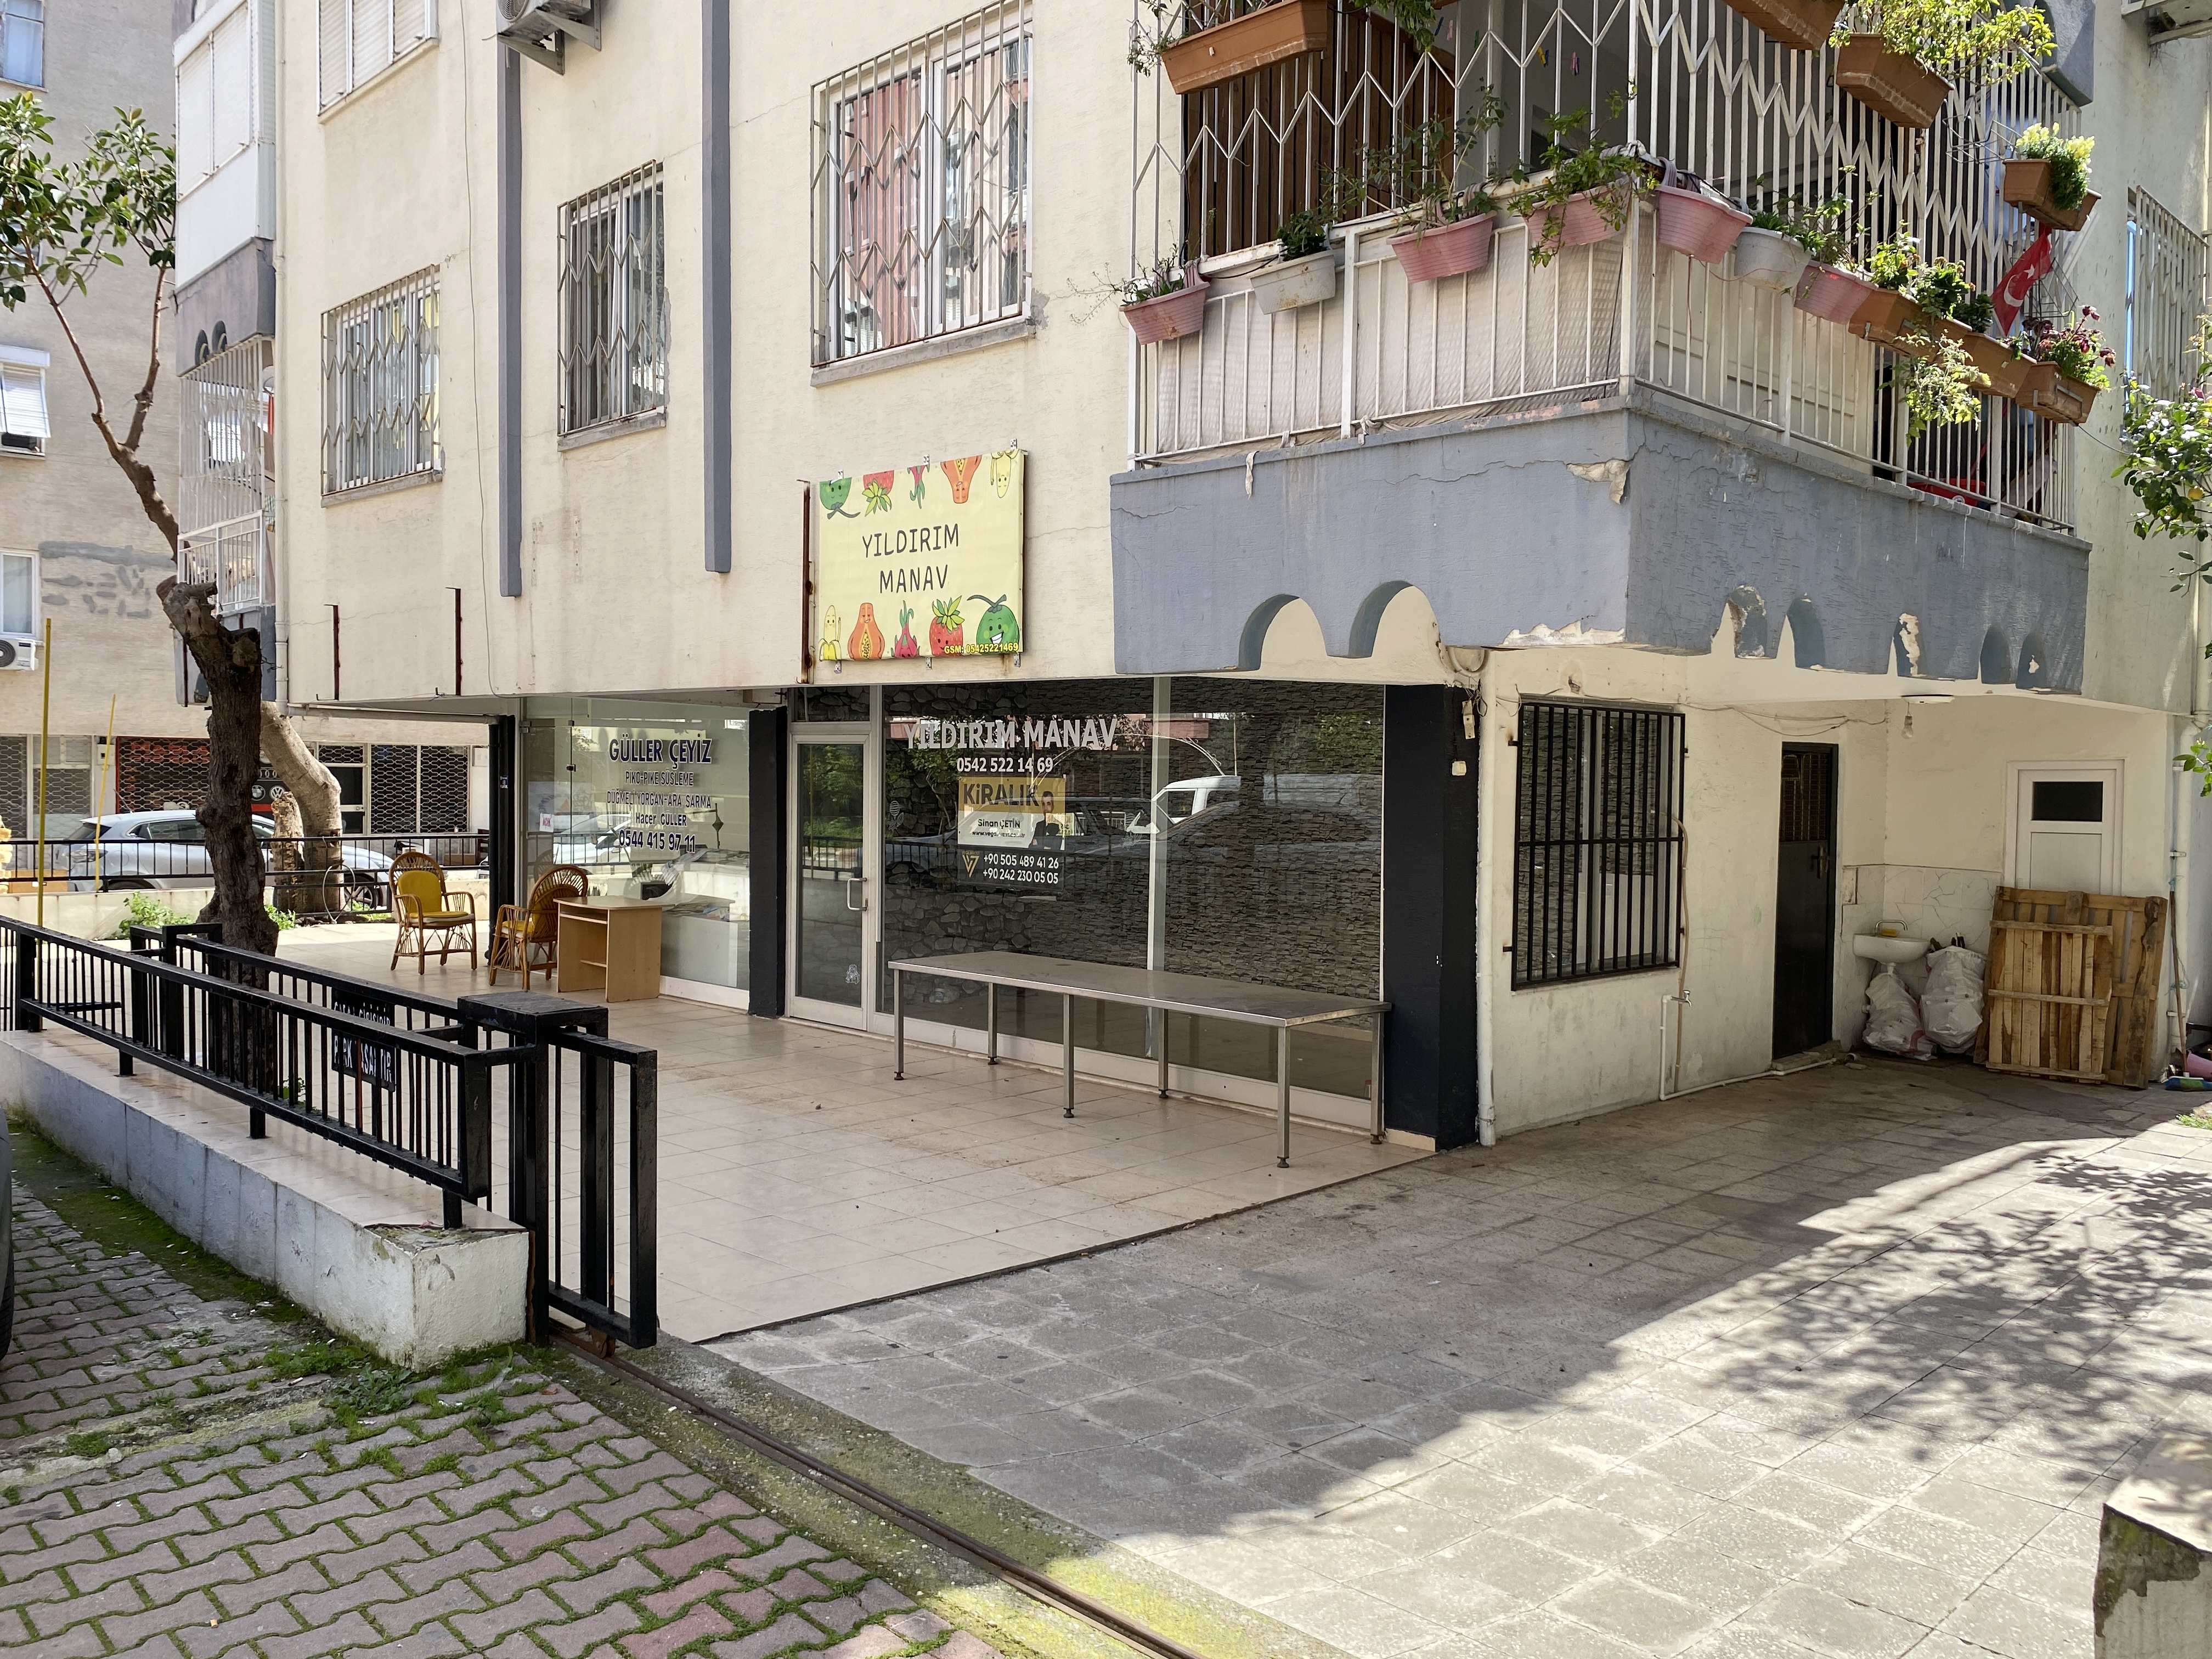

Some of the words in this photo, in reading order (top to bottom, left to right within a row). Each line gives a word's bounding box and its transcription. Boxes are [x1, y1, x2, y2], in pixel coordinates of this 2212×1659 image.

[862, 523, 959, 558] YILDIRIM
[880, 564, 948, 594] MANAV
[944, 645, 964, 654] GSM:
[966, 642, 1019, 653] 05425221469
[904, 721, 1015, 749] YILDIRIM
[1024, 718, 1118, 748] MANAV
[609, 733, 663, 763] GÜLLER
[669, 733, 713, 770] ÇEYİZ
[957, 757, 986, 772] 0542
[990, 757, 1014, 772] 522
[1018, 757, 1033, 772] 14
[1037, 757, 1053, 772] 69
[625, 769, 659, 785] PİKO-PİKE
[661, 768, 693, 786] SÜSLEME
[607, 788, 635, 805] DÜĞMELİ
[636, 792, 682, 807] YORGAN-ARA
[685, 794, 712, 809] SARMA
[635, 812, 657, 825] Hacer
[978, 819, 998, 827] Sinan
[1000, 818, 1020, 829] ÇETİN
[619, 829, 643, 848] 0544
[647, 831, 665, 850] 415
[669, 833, 681, 851] 97
[684, 834, 696, 853] 11
[984, 853, 998, 865] +90
[1000, 854, 1017, 866] 505
[1019, 855, 1035, 867] 489
[1036, 856, 1046, 868] 41
[1048, 857, 1059, 869] 26
[983, 867, 998, 879] +90
[1000, 868, 1015, 881] 242
[1017, 870, 1032, 882] 230
[1034, 871, 1045, 883] 05
[1047, 872, 1058, 884] 05
[334, 1035, 353, 1069] PRK
